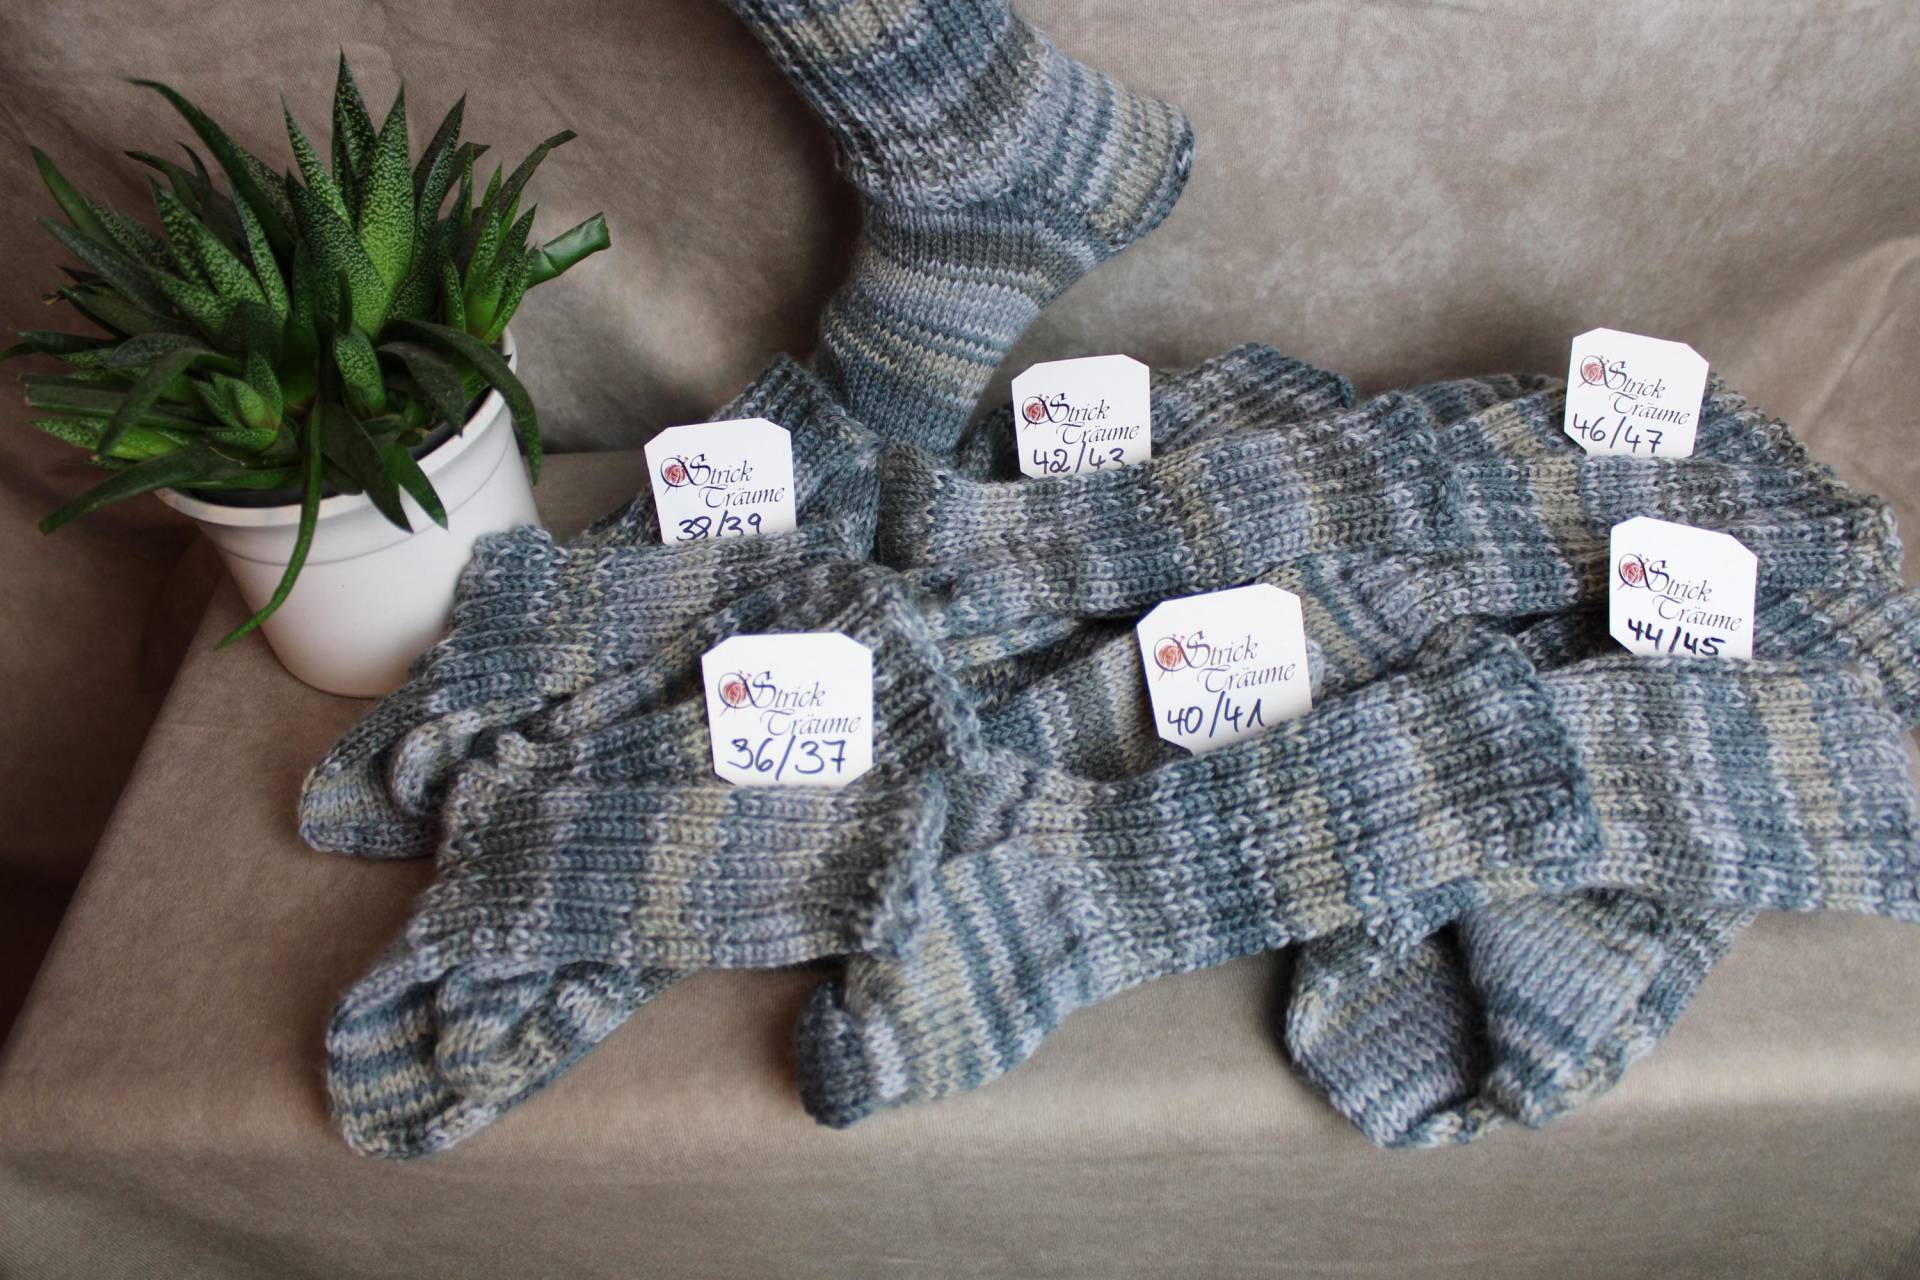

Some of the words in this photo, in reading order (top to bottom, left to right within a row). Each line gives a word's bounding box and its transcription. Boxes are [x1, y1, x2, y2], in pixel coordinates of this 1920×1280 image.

[1580, 355, 1666, 399] Strick
[1022, 393, 1110, 424] Strick
[1609, 391, 1691, 425] Träume
[1056, 422, 1140, 444] Träume
[1573, 413, 1663, 453] 46/47
[660, 453, 753, 487] Strick
[698, 485, 785, 508] Träume
[1618, 553, 1712, 602] Strick
[1652, 594, 1742, 631] Träume
[1154, 630, 1258, 672] Strick
[1627, 618, 1726, 657] 44/45
[718, 670, 826, 709] Strick
[1197, 664, 1296, 693] Träume
[760, 708, 862, 736] Träume
[1167, 690, 1265, 738] 40/41
[727, 735, 847, 781] 36/37
